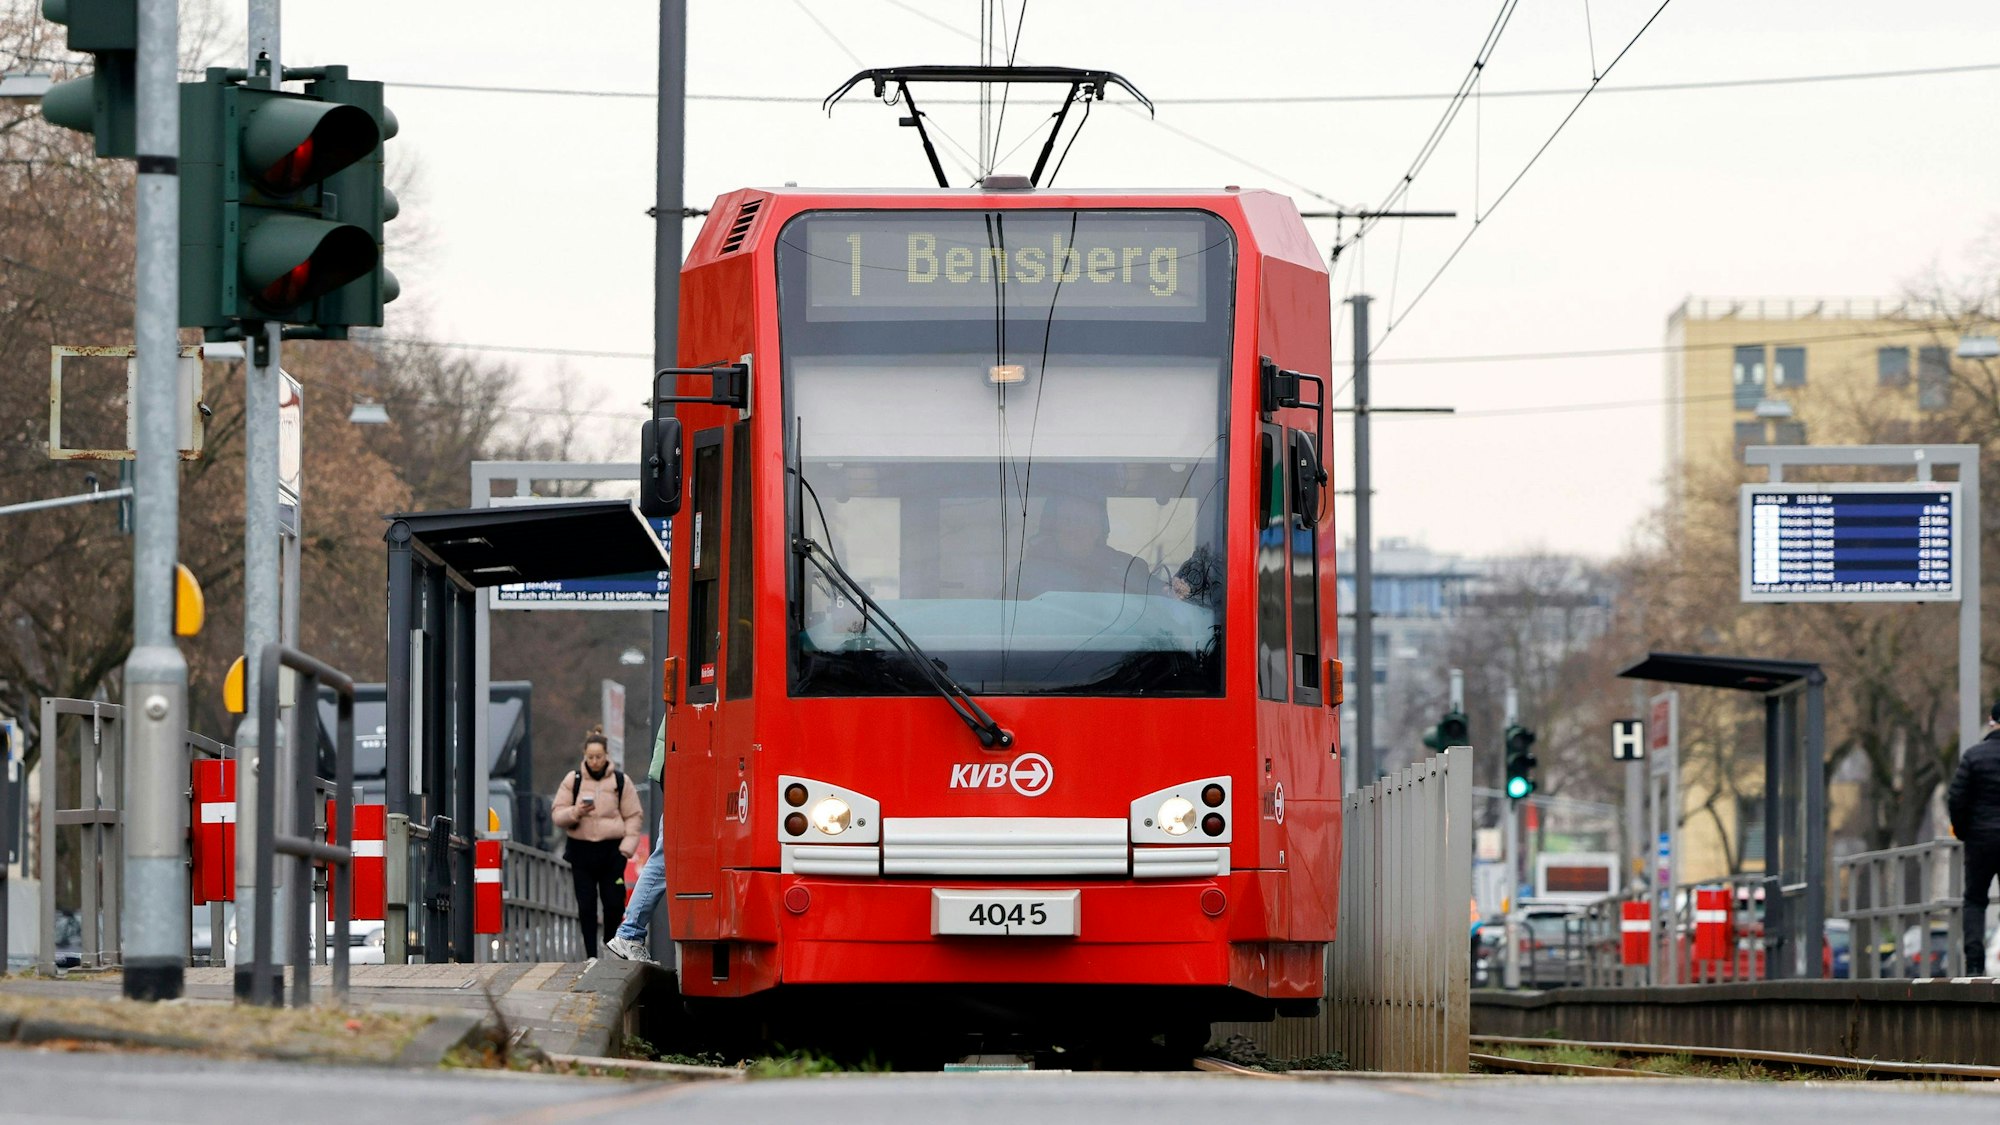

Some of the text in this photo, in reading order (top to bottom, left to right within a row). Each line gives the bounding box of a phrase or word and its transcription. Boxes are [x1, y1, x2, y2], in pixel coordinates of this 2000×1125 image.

[846, 232, 1177, 296] 1 Bensberg
[501, 591, 518, 600] sind
[518, 591, 538, 600] auch
[538, 591, 551, 600] die
[552, 591, 576, 600] Linien
[577, 591, 588, 600] 16
[588, 591, 604, 600] und
[1613, 722, 1643, 758] H
[950, 763, 1009, 789] KVB
[969, 903, 1047, 926] 4045
